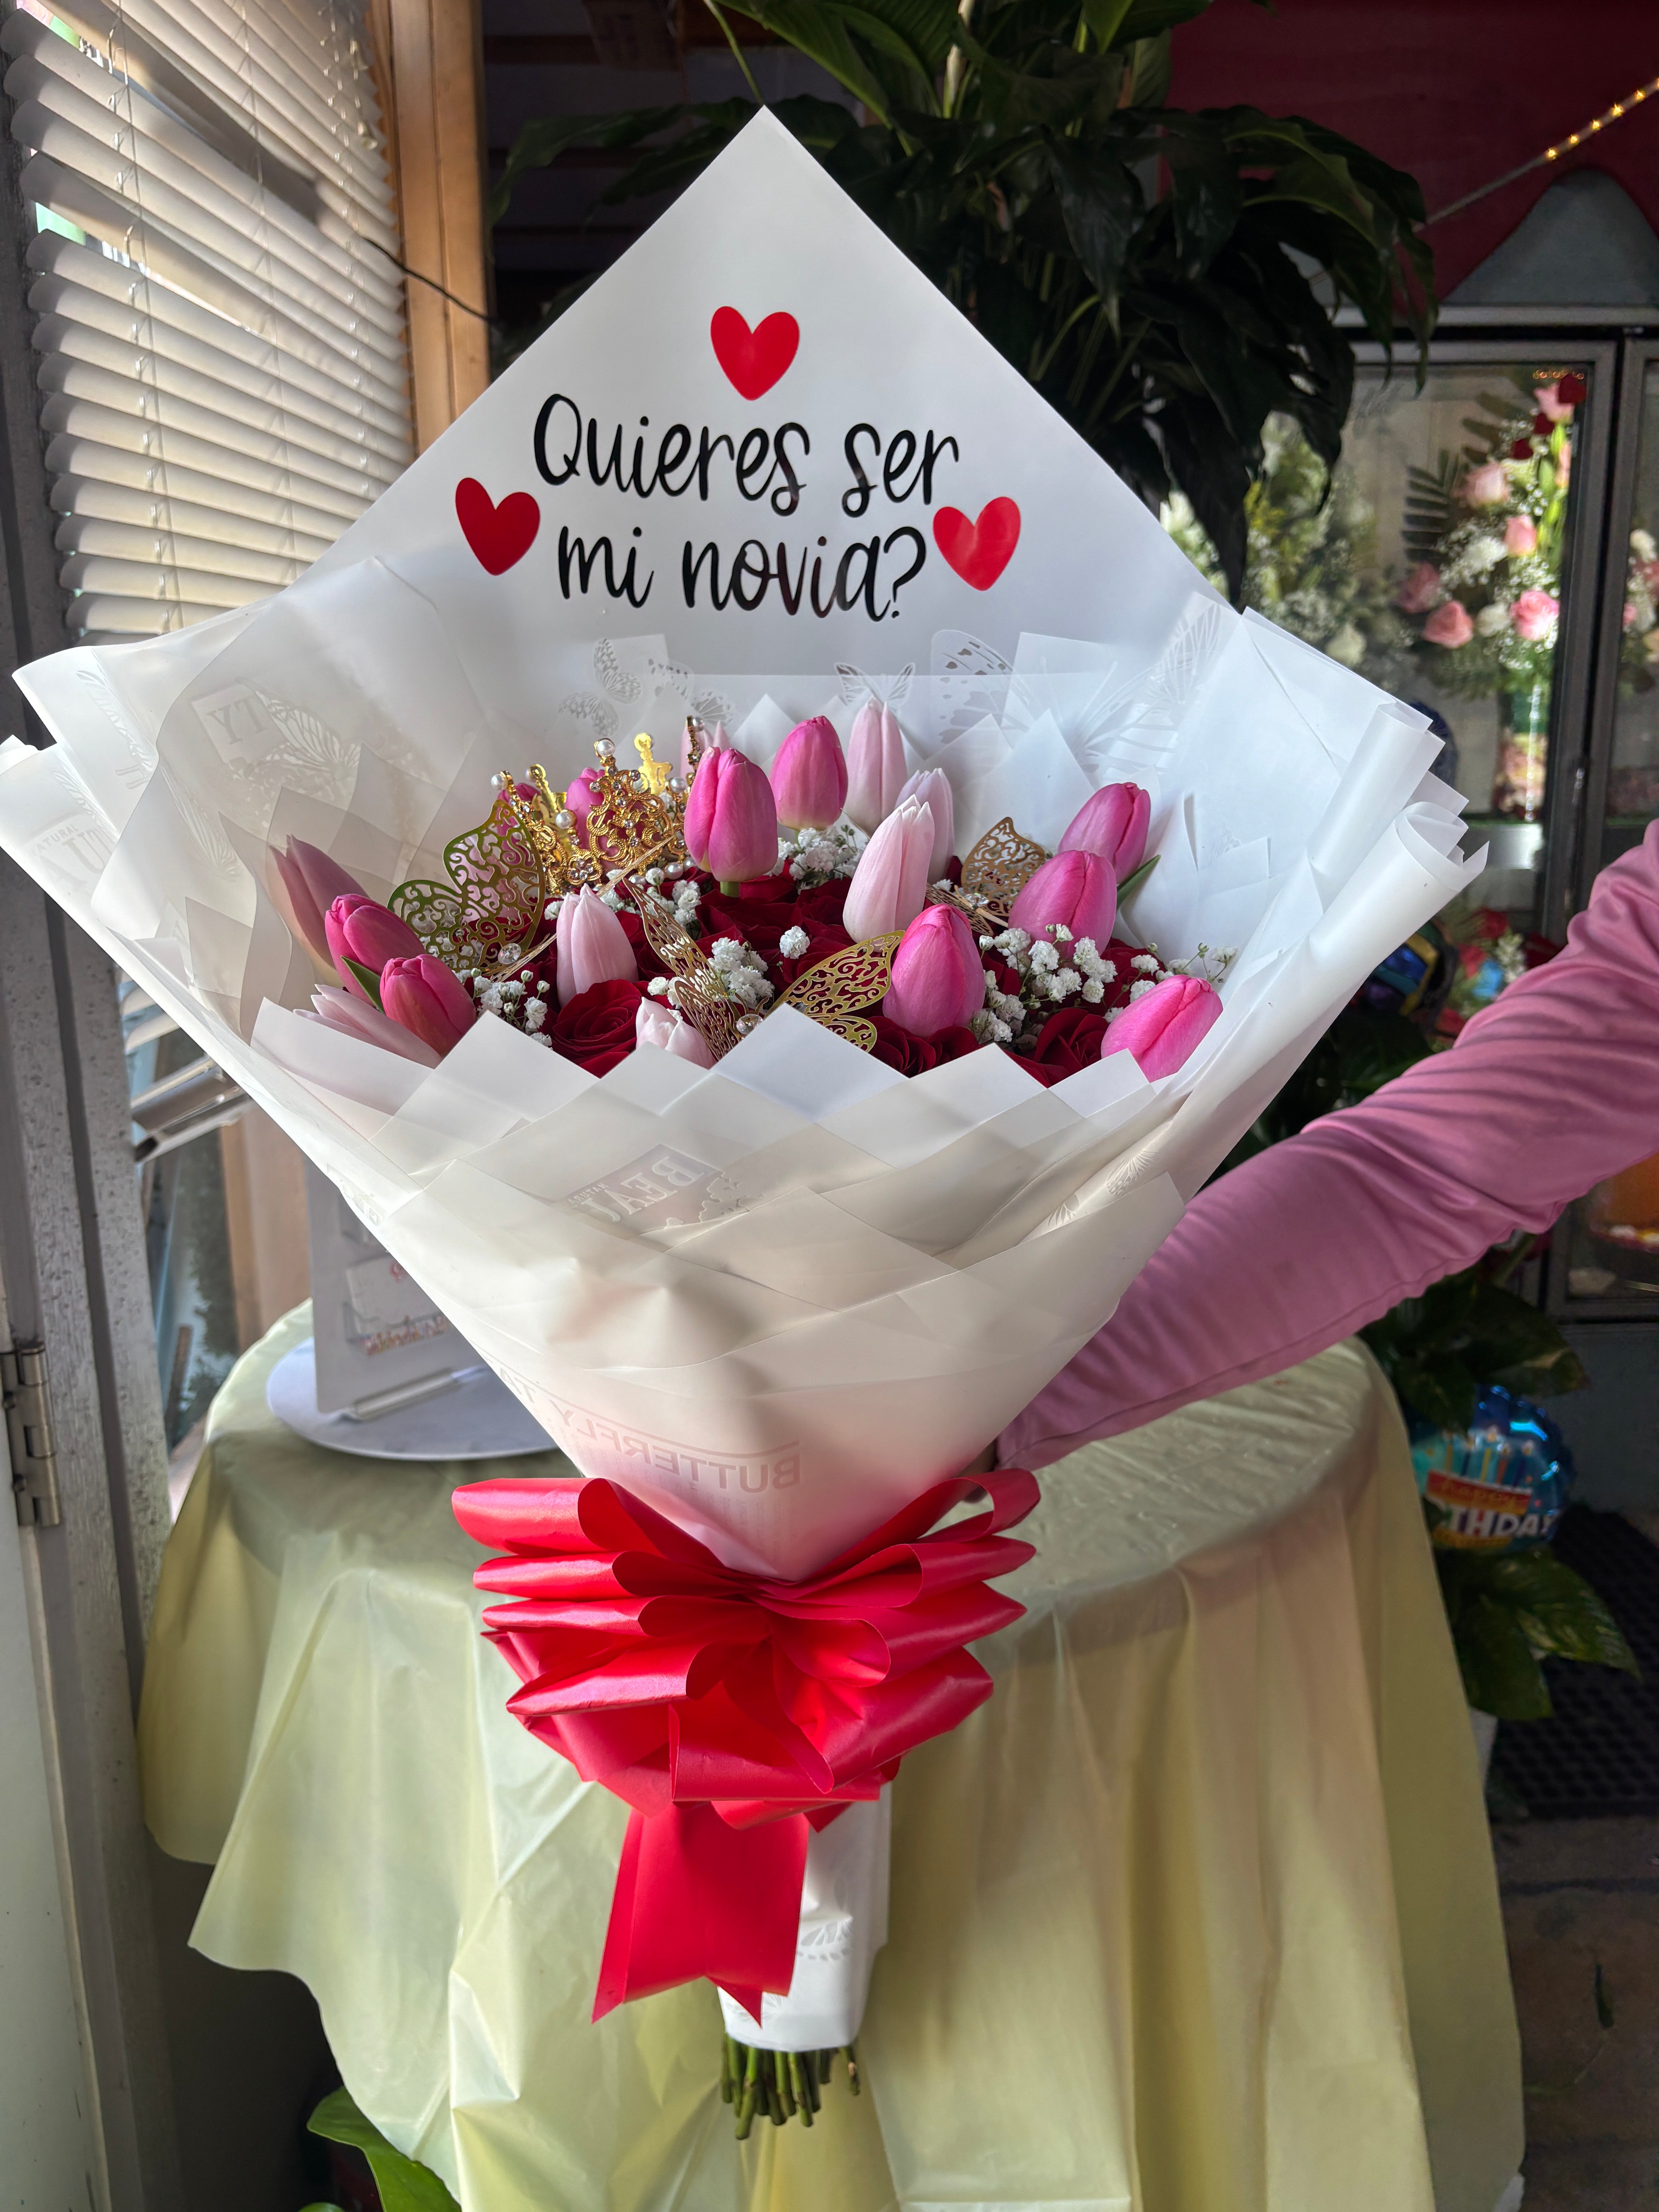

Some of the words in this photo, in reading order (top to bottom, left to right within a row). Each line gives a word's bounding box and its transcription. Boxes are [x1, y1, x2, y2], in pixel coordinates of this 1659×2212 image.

[534, 393, 810, 517] Quieres
[842, 423, 959, 518] ser
[558, 526, 654, 608] mi
[682, 526, 926, 622] novia?
[33, 824, 78, 857] ATURAL
